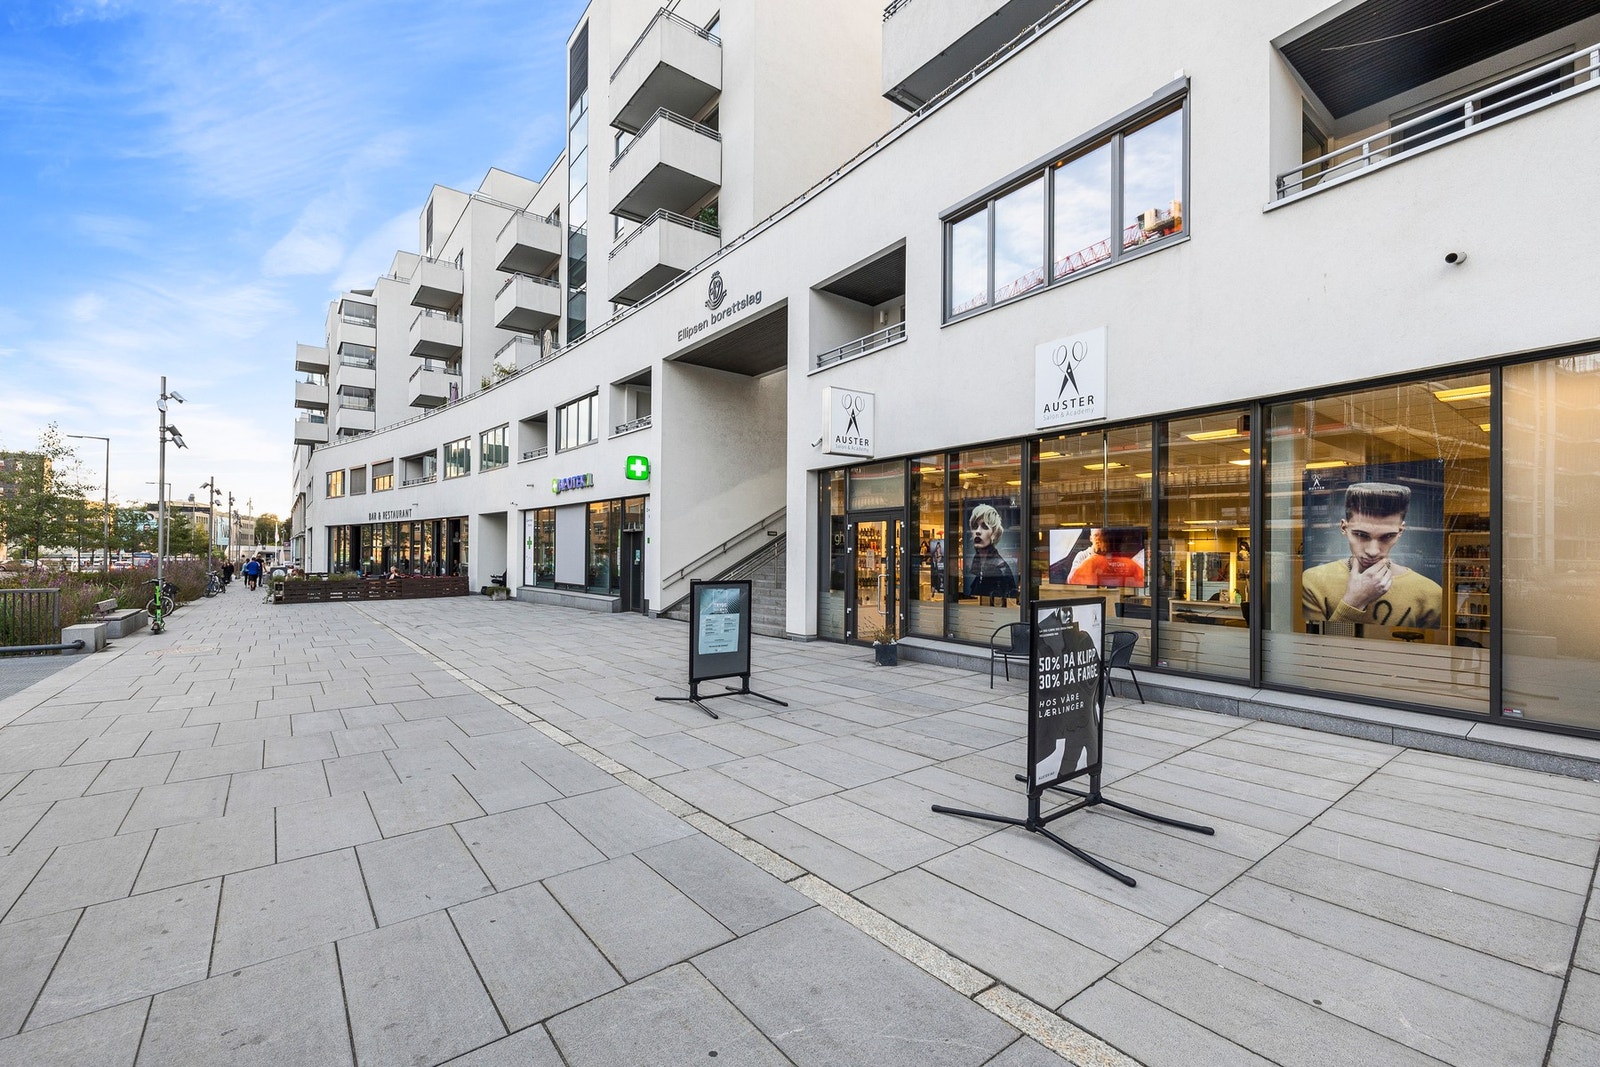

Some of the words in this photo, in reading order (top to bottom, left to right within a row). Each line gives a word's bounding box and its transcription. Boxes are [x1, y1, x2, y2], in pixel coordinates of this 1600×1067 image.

[677, 319, 709, 342] Ellipsen
[710, 290, 762, 326] borettslag
[1043, 394, 1095, 414] AUSTER
[1043, 412, 1060, 421] Salon
[1066, 407, 1095, 417] Academy
[835, 435, 870, 447] AUSTER
[557, 474, 586, 493] APOTEK
[368, 512, 377, 521] BAR
[382, 508, 413, 520] RESTAURANT
[1038, 656, 1060, 673] 50%
[1063, 651, 1075, 669] PÅ
[1077, 648, 1096, 666] KLIPP
[1038, 673, 1061, 690] 30%
[1063, 669, 1076, 686] PÅ
[1077, 663, 1099, 682] FARGE
[1038, 697, 1057, 709] HOS
[1060, 692, 1080, 704] VÅRE
[1038, 701, 1084, 719] LÆRLINGER
